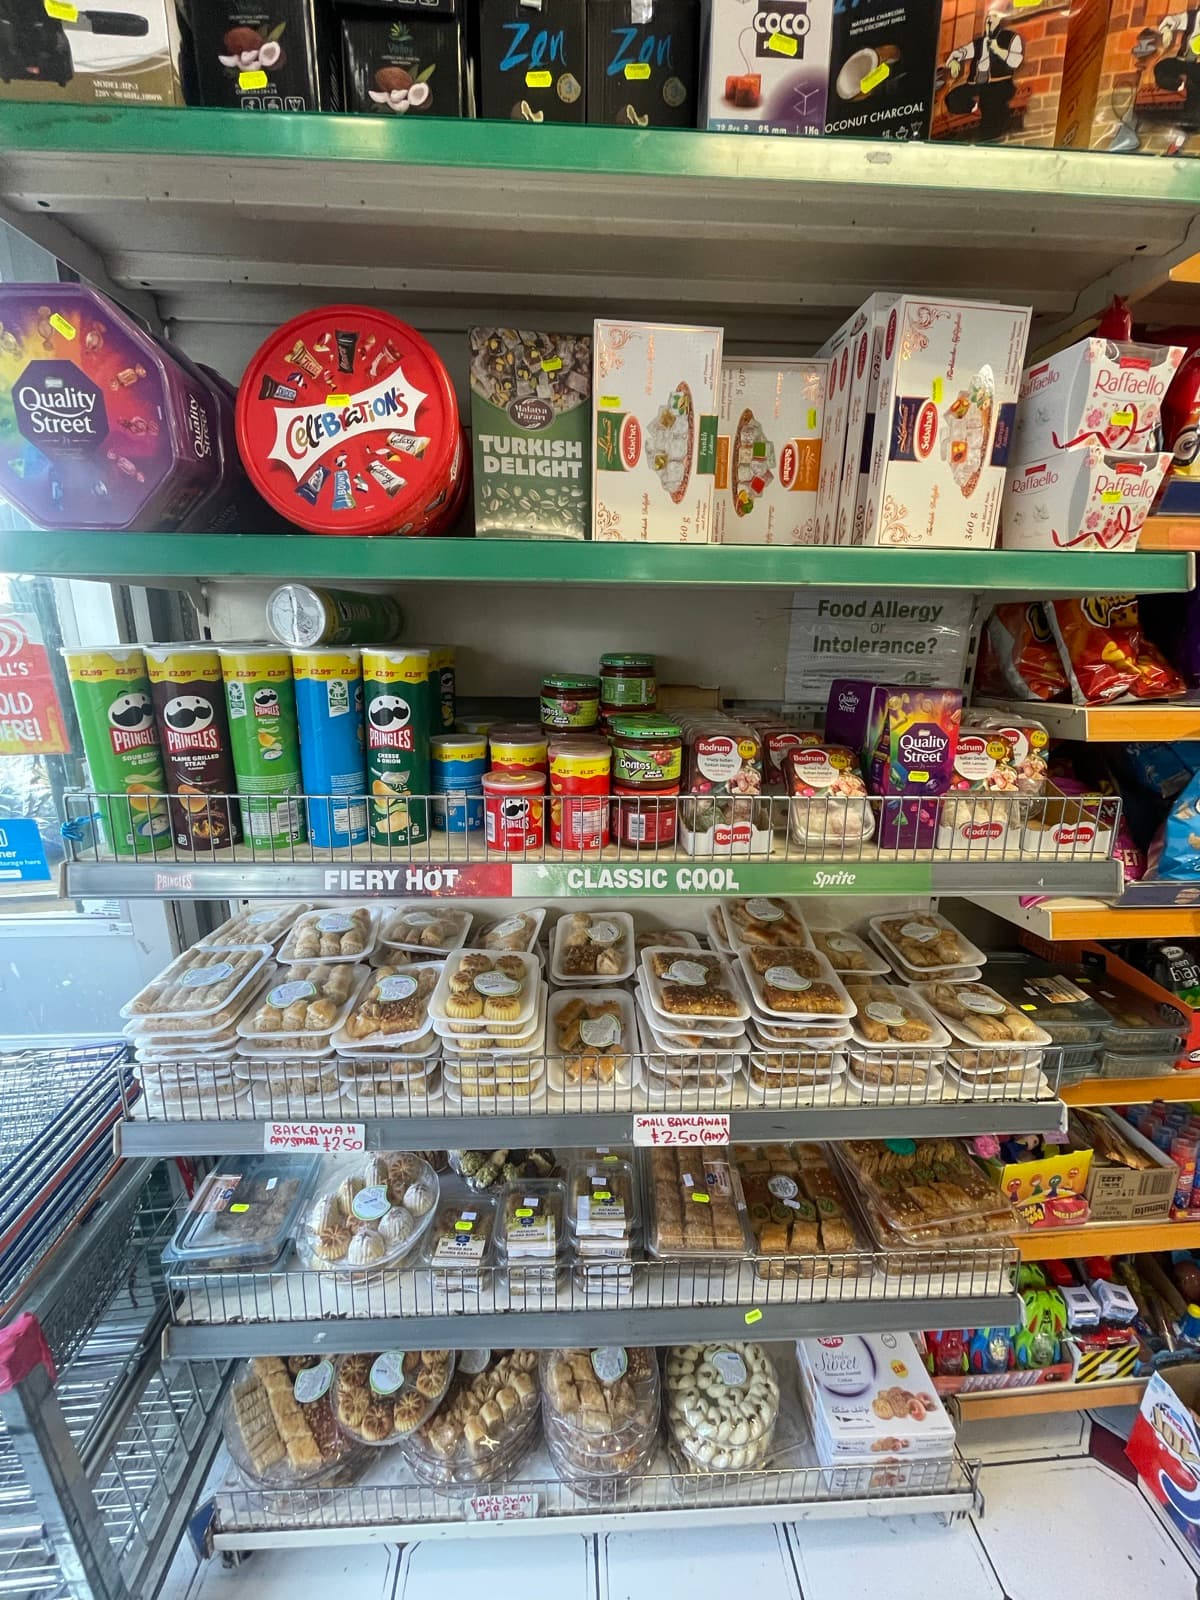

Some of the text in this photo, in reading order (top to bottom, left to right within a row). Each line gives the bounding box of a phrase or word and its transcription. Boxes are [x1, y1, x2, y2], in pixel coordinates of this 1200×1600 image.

[753, 12, 811, 36] COCO
[500, 23, 568, 70] Zen
[607, 27, 674, 76] Zen
[825, 101, 925, 134] OCONUT CHARCOAL
[1095, 369, 1165, 396] Raffaello
[19, 386, 96, 413] Quality
[31, 410, 94, 434] Street
[187, 394, 205, 459] Quality
[478, 434, 583, 459] TURKISH
[483, 456, 583, 479] DELIGHT
[1012, 471, 1059, 493] Raffaello
[1095, 475, 1155, 498] Raffaello
[964, 521, 974, 541] 360
[818, 600, 943, 623] Food Allergy
[813, 635, 938, 655] Intolerance?
[0, 661, 29, 676] LL'S
[0, 692, 33, 716] OLD
[0, 718, 42, 742] ERE!
[112, 729, 157, 753] PRINGLE
[167, 728, 218, 751] PRINGLES
[369, 727, 411, 750] PRINGLES
[699, 742, 730, 753] Bodrum
[899, 735, 948, 752] Quality
[956, 743, 982, 752] odrum
[620, 759, 651, 770] Doritos
[793, 754, 825, 762] Bodrum
[903, 750, 942, 763] Street
[1058, 830, 1091, 841] Bodum
[156, 873, 193, 890] PRINGLES
[324, 868, 459, 891] FIERY HOT
[567, 867, 740, 892] CLASSIC COOL
[812, 870, 857, 888] Sprite
[272, 1124, 356, 1137] BAKLAWAH
[636, 1116, 728, 1127] SMALL BAKLAWAH
[650, 1128, 730, 1145] £2.50 (ANY)
